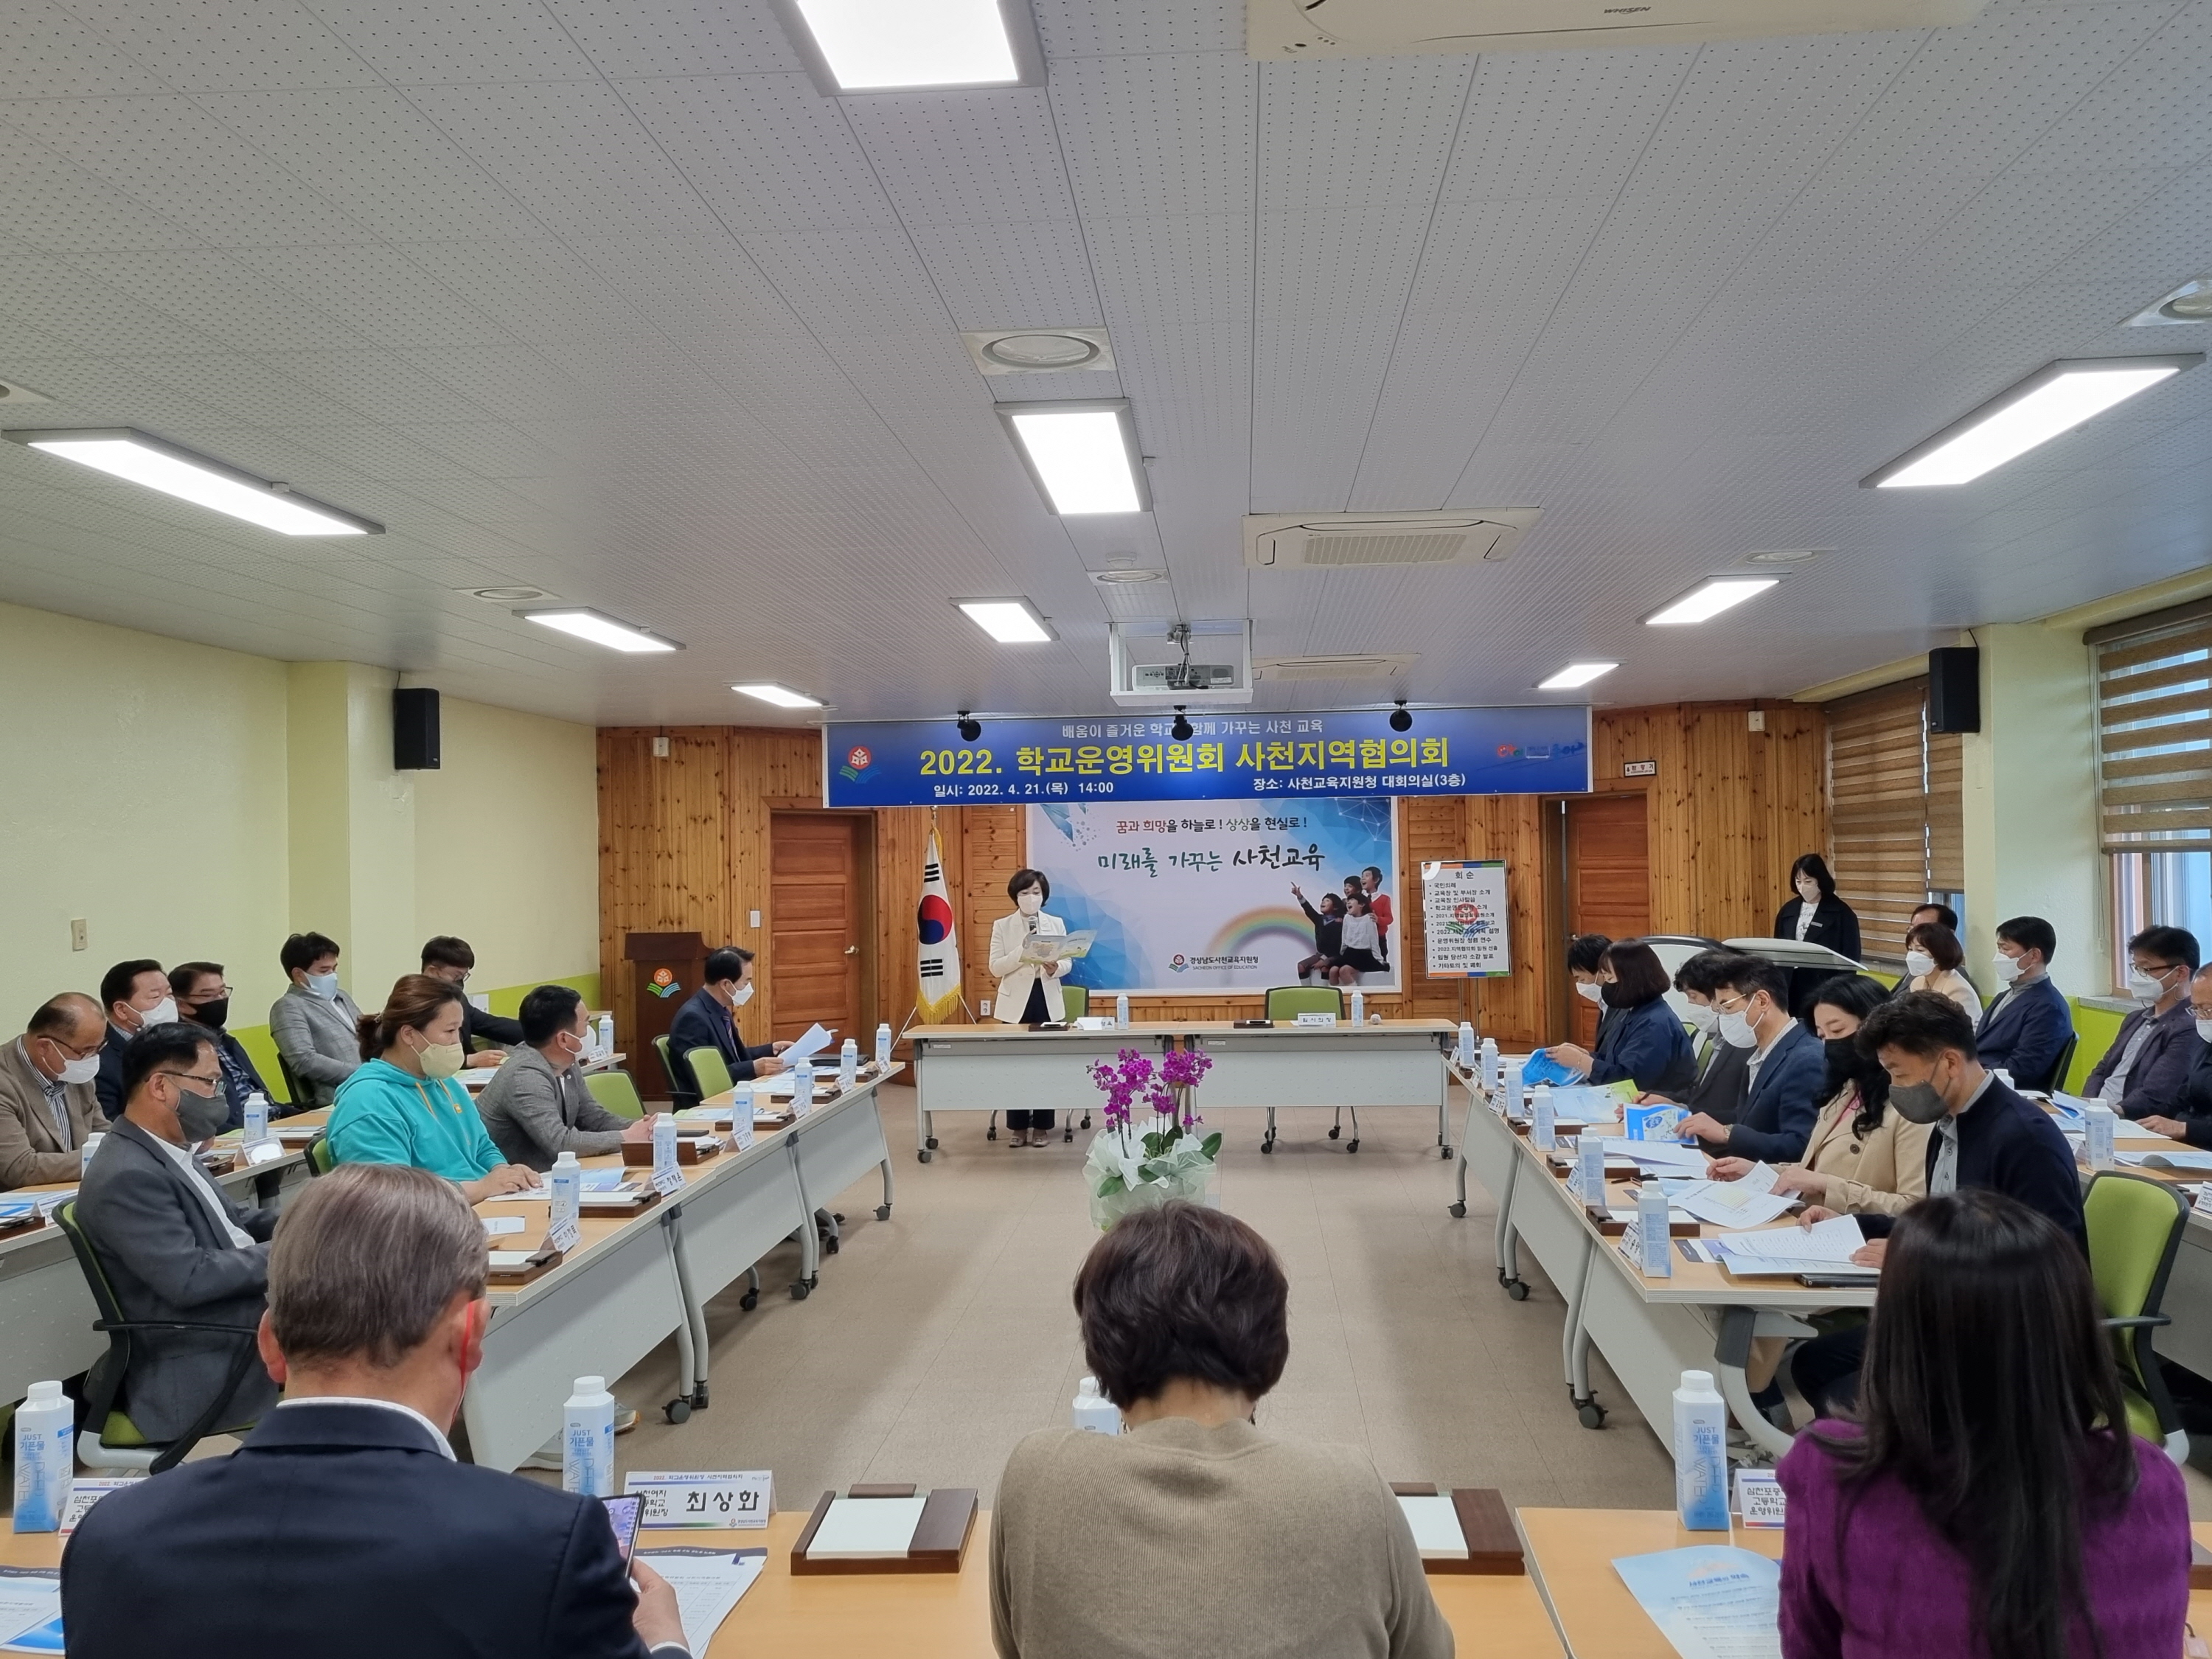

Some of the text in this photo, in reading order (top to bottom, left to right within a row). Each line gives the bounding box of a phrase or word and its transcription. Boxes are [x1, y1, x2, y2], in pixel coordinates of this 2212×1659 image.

[1062, 724, 1102, 739] 배움이
[1106, 723, 1145, 738] 즐거운
[1221, 721, 1261, 735] 가꾸는
[1265, 720, 1292, 734] 사천
[1296, 719, 1324, 733] 교육
[919, 737, 1449, 776] 2022. 학교운영위원회 사천지역협의회
[933, 782, 1114, 799] 일시: 2022. 4. 21.(목) 14:00
[1253, 773, 1466, 792] 장소: 사천교육지원청 대회의실(3층)
[1116, 819, 1140, 834] 꿈과
[1143, 818, 1178, 833] 희망을
[1226, 817, 1262, 832] 상상을
[1098, 843, 1326, 877] 미래를 가꾸는 사천교육
[1189, 956, 1259, 964] 경상남도사천교육지원청
[22, 1433, 43, 1441] JUST
[1696, 1426, 1717, 1434] JUST
[19, 1440, 46, 1452] 기픈물
[569, 1436, 594, 1447] 기픈물
[1693, 1433, 1720, 1445] 기픈물
[34, 1461, 46, 1498] DEEP
[568, 1458, 580, 1495] WATE
[582, 1458, 595, 1494] DEEP
[1693, 1455, 1708, 1505] WATER
[1709, 1455, 1722, 1493] DEEP
[18, 1462, 31, 1509] WATER
[1747, 1486, 1781, 1497] 삼천포중
[644, 1497, 666, 1508] 등학교
[1749, 1506, 1785, 1516] 운영위원
[644, 1508, 669, 1517] 위원장
